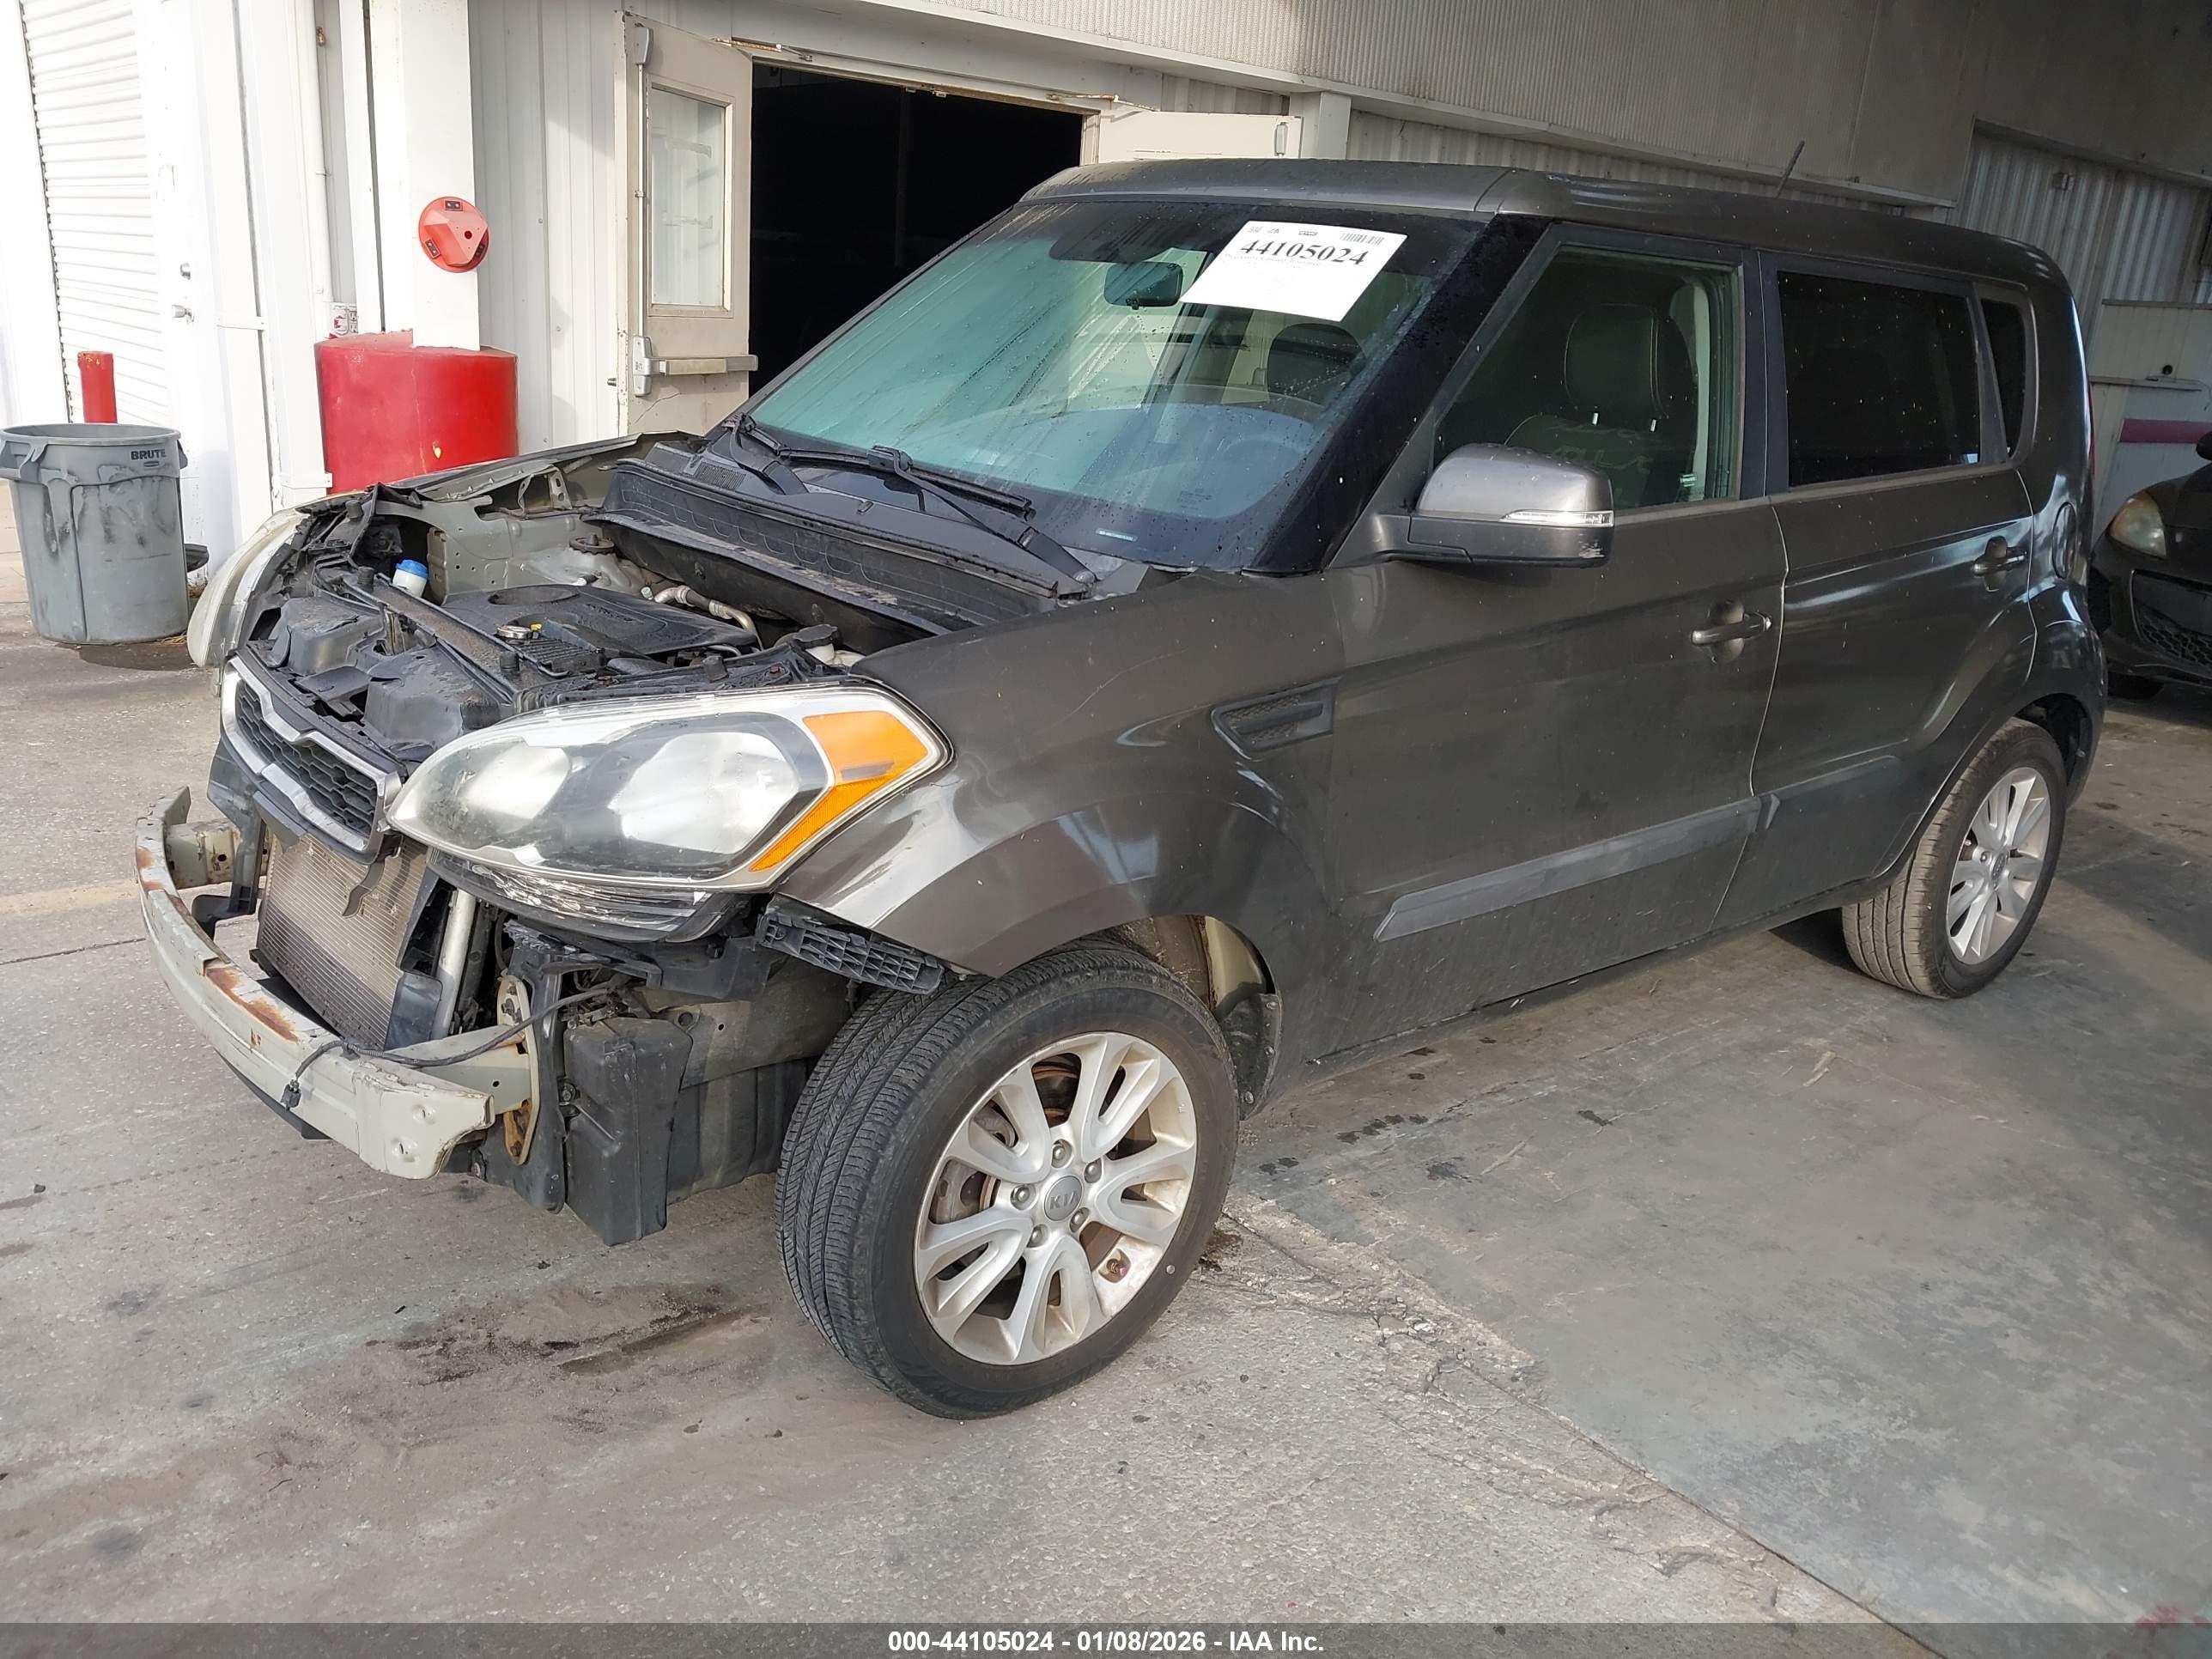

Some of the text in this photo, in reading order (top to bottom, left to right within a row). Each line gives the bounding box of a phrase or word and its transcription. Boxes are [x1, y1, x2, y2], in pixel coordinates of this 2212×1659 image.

[1240, 240, 1370, 265] 44105024
[131, 449, 166, 460] BRUTE
[1049, 1190, 1081, 1210] KIA
